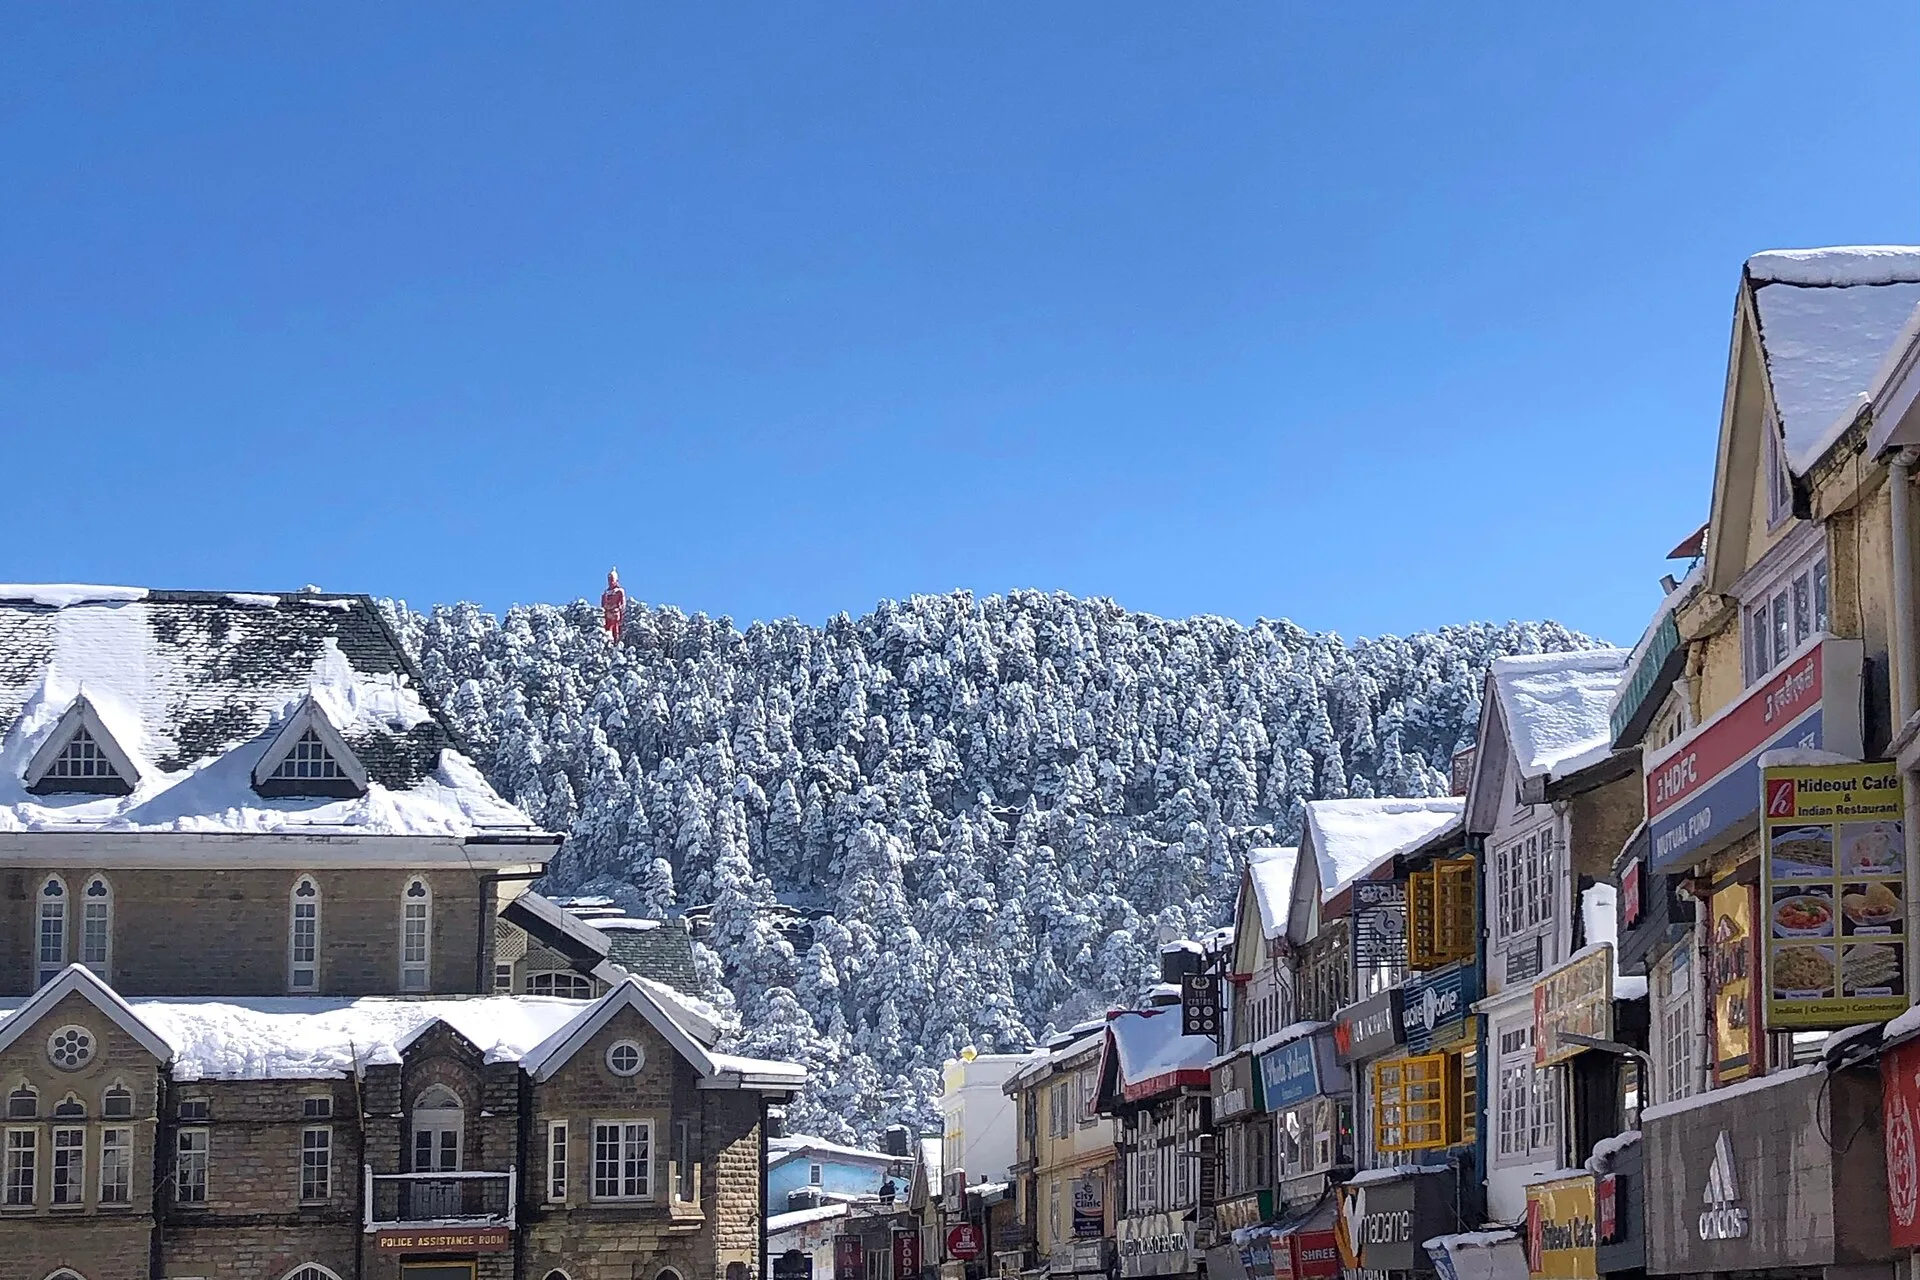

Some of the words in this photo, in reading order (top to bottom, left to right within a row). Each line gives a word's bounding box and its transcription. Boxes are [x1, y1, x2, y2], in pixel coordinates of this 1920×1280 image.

[1664, 752, 1697, 801] HDFC
[1797, 777, 1857, 793] Hideout
[1861, 774, 1898, 791] Café
[1843, 793, 1852, 803] &
[1798, 806, 1833, 817] Indian
[1835, 802, 1898, 816] Restaurant
[1656, 823, 1688, 858] MUTUAL
[1688, 807, 1711, 839] FUND
[1074, 1191, 1094, 1202] City
[1075, 1199, 1101, 1208] Clinic
[380, 1237, 413, 1248] POLICE
[417, 1235, 475, 1247] ASSISTANCE
[478, 1235, 505, 1245] ROOM
[902, 1238, 913, 1276] FOOD
[1301, 1247, 1336, 1261] SHREE
